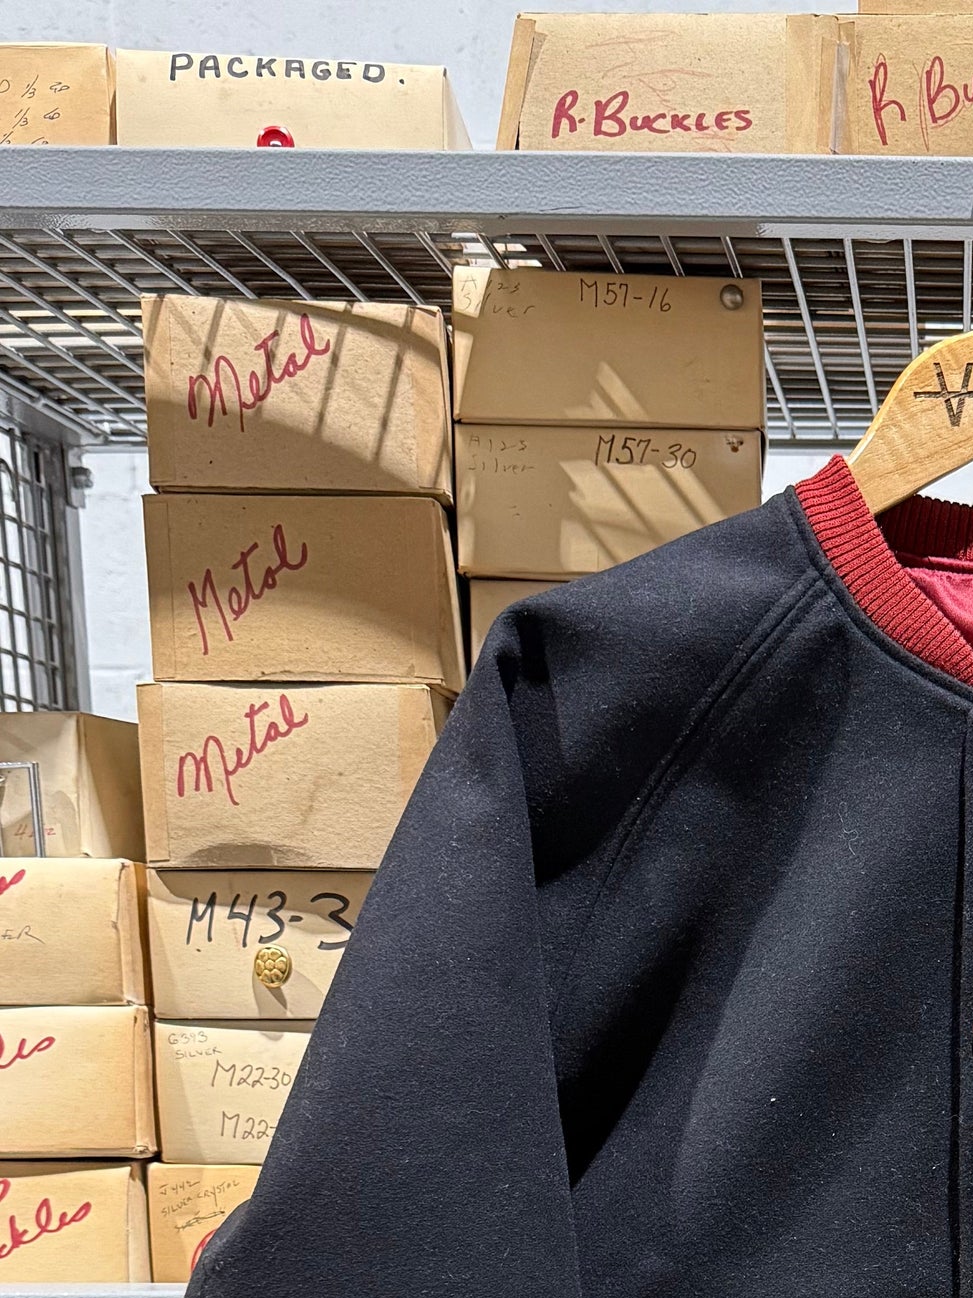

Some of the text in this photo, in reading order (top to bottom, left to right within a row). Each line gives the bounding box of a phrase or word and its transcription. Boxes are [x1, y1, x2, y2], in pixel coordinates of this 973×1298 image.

[580, 279, 673, 313] M57-16
[188, 313, 331, 433] Metal
[595, 435, 697, 469] M57-30
[188, 524, 309, 655] Metal
[178, 694, 309, 806] Metal
[211, 1060, 292, 1090] M22-30
